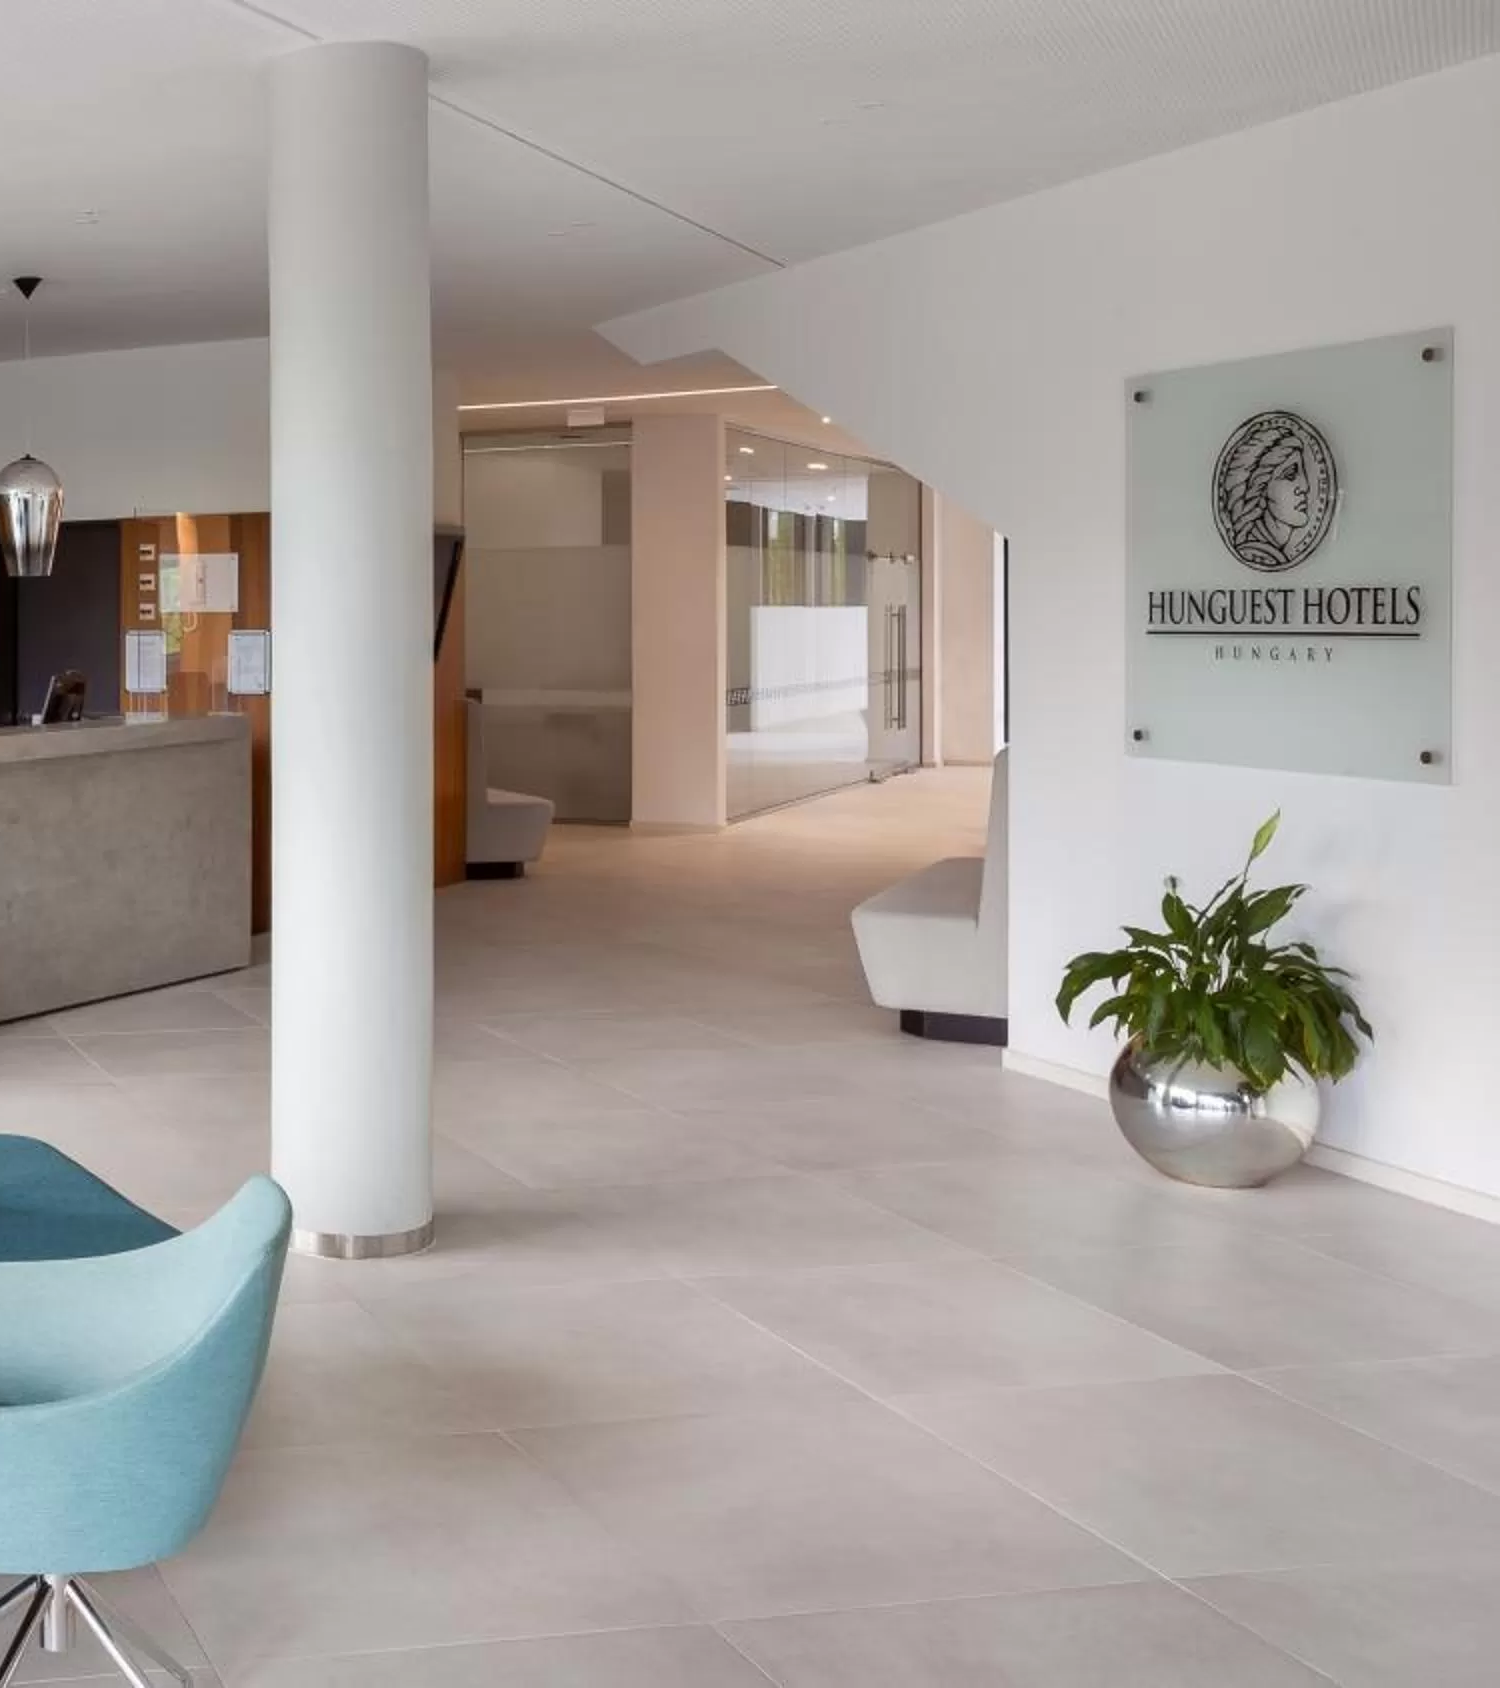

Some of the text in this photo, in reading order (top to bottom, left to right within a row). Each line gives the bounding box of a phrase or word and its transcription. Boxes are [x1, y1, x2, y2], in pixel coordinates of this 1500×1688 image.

[1148, 585, 1421, 625] HUNGUEST HOTELS
[1215, 646, 1333, 662] HUNGARY
